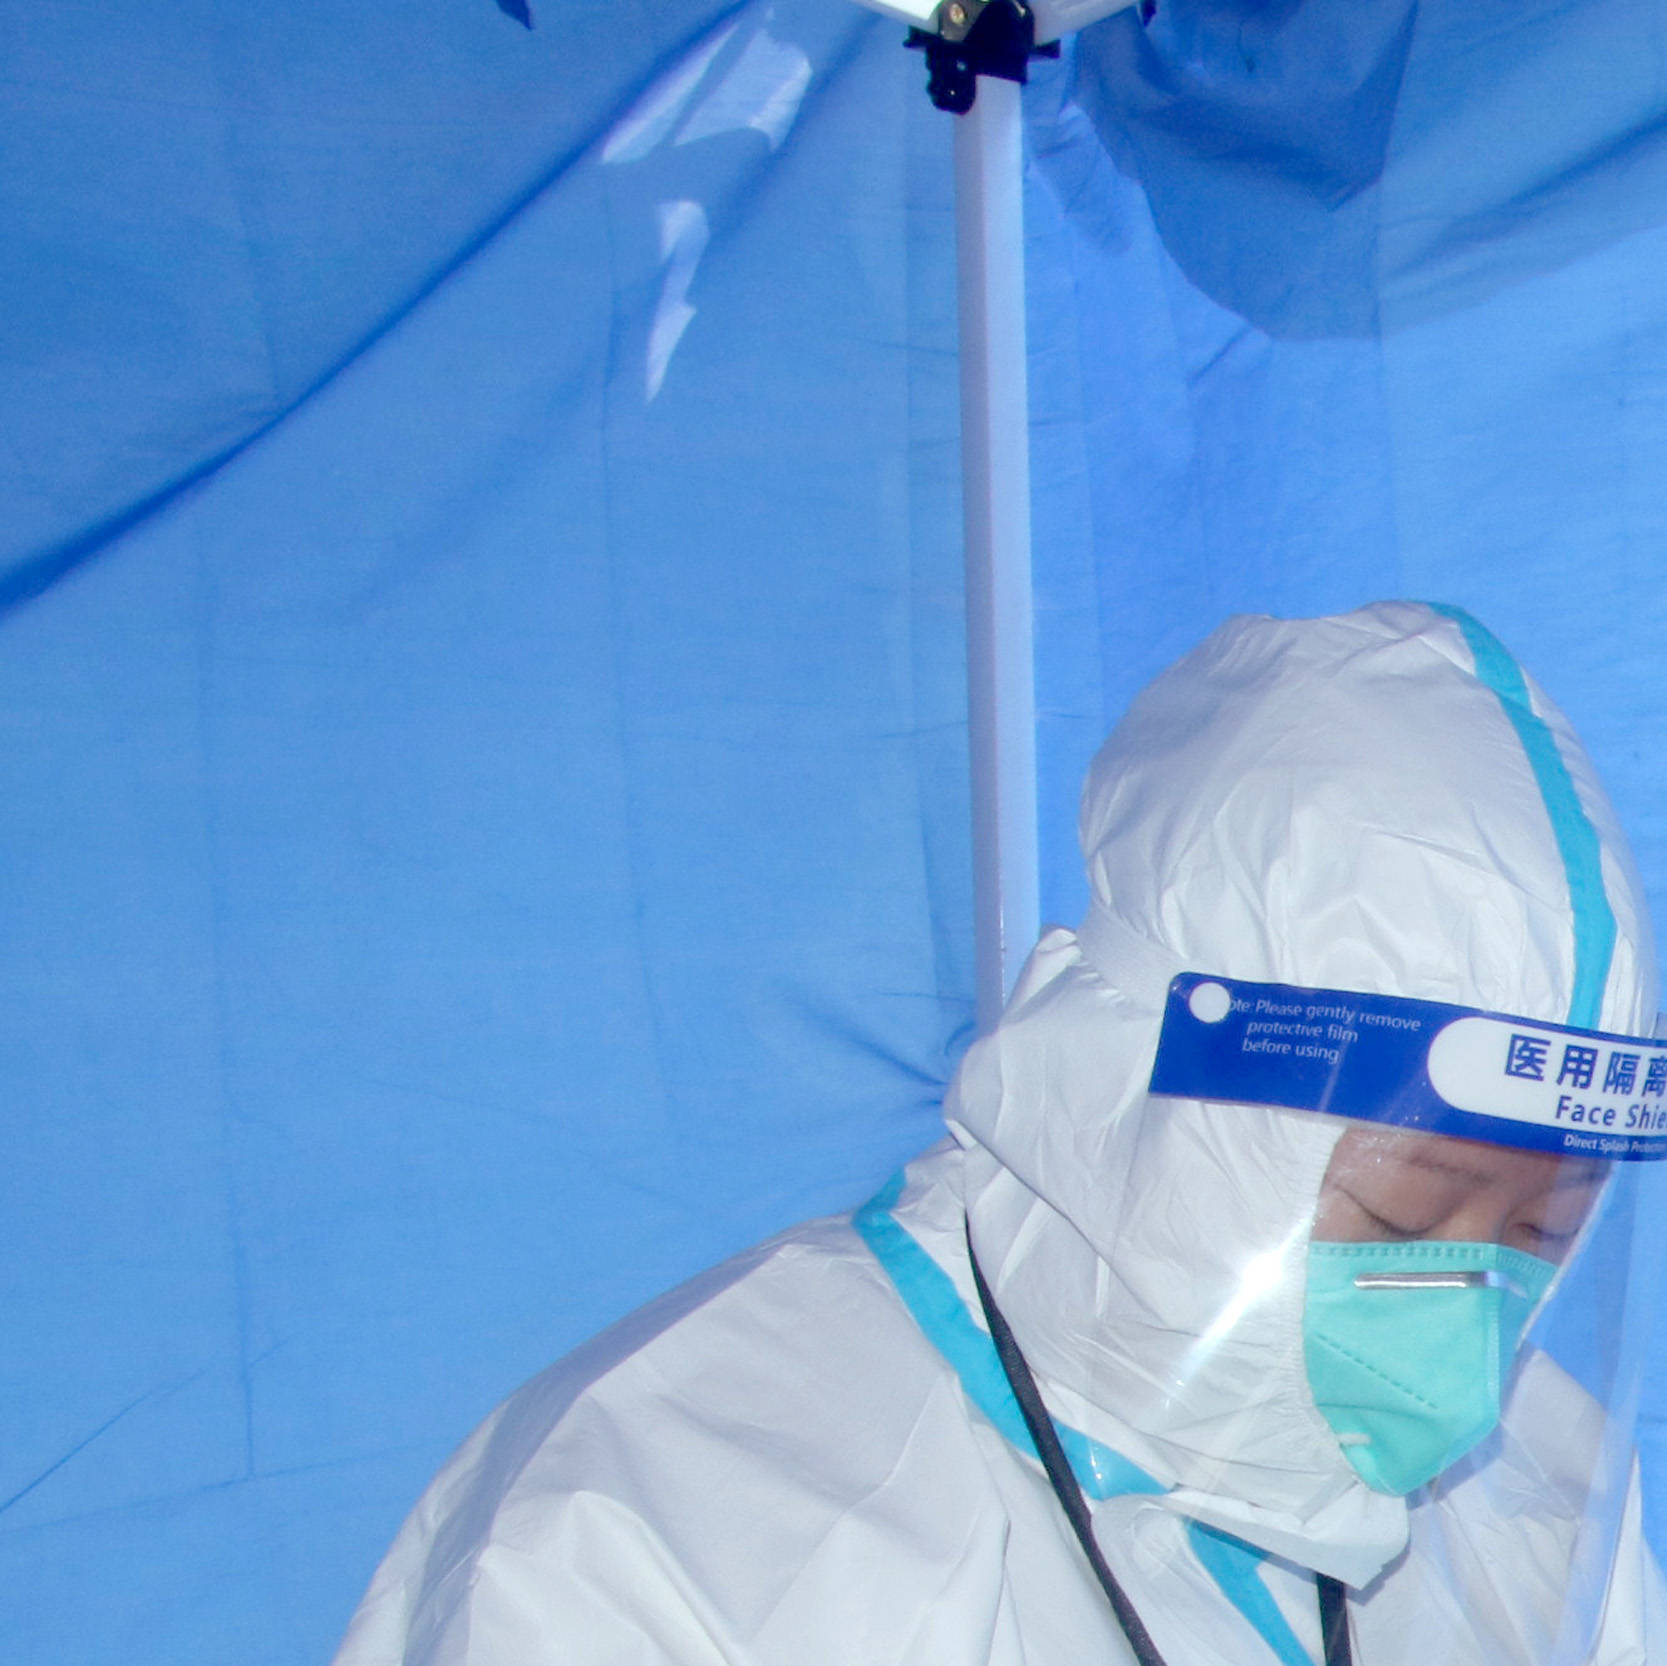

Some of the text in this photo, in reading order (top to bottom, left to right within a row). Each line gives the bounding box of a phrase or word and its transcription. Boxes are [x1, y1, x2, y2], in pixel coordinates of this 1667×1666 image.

[1255, 999, 1302, 1017] Please
[1306, 1004, 1356, 1023] gently
[1359, 1012, 1422, 1032] remove
[1246, 1020, 1359, 1043] protective film
[1242, 1037, 1340, 1064] before using
[1555, 1095, 1616, 1127] Face
[1563, 1133, 1598, 1150] Direct
